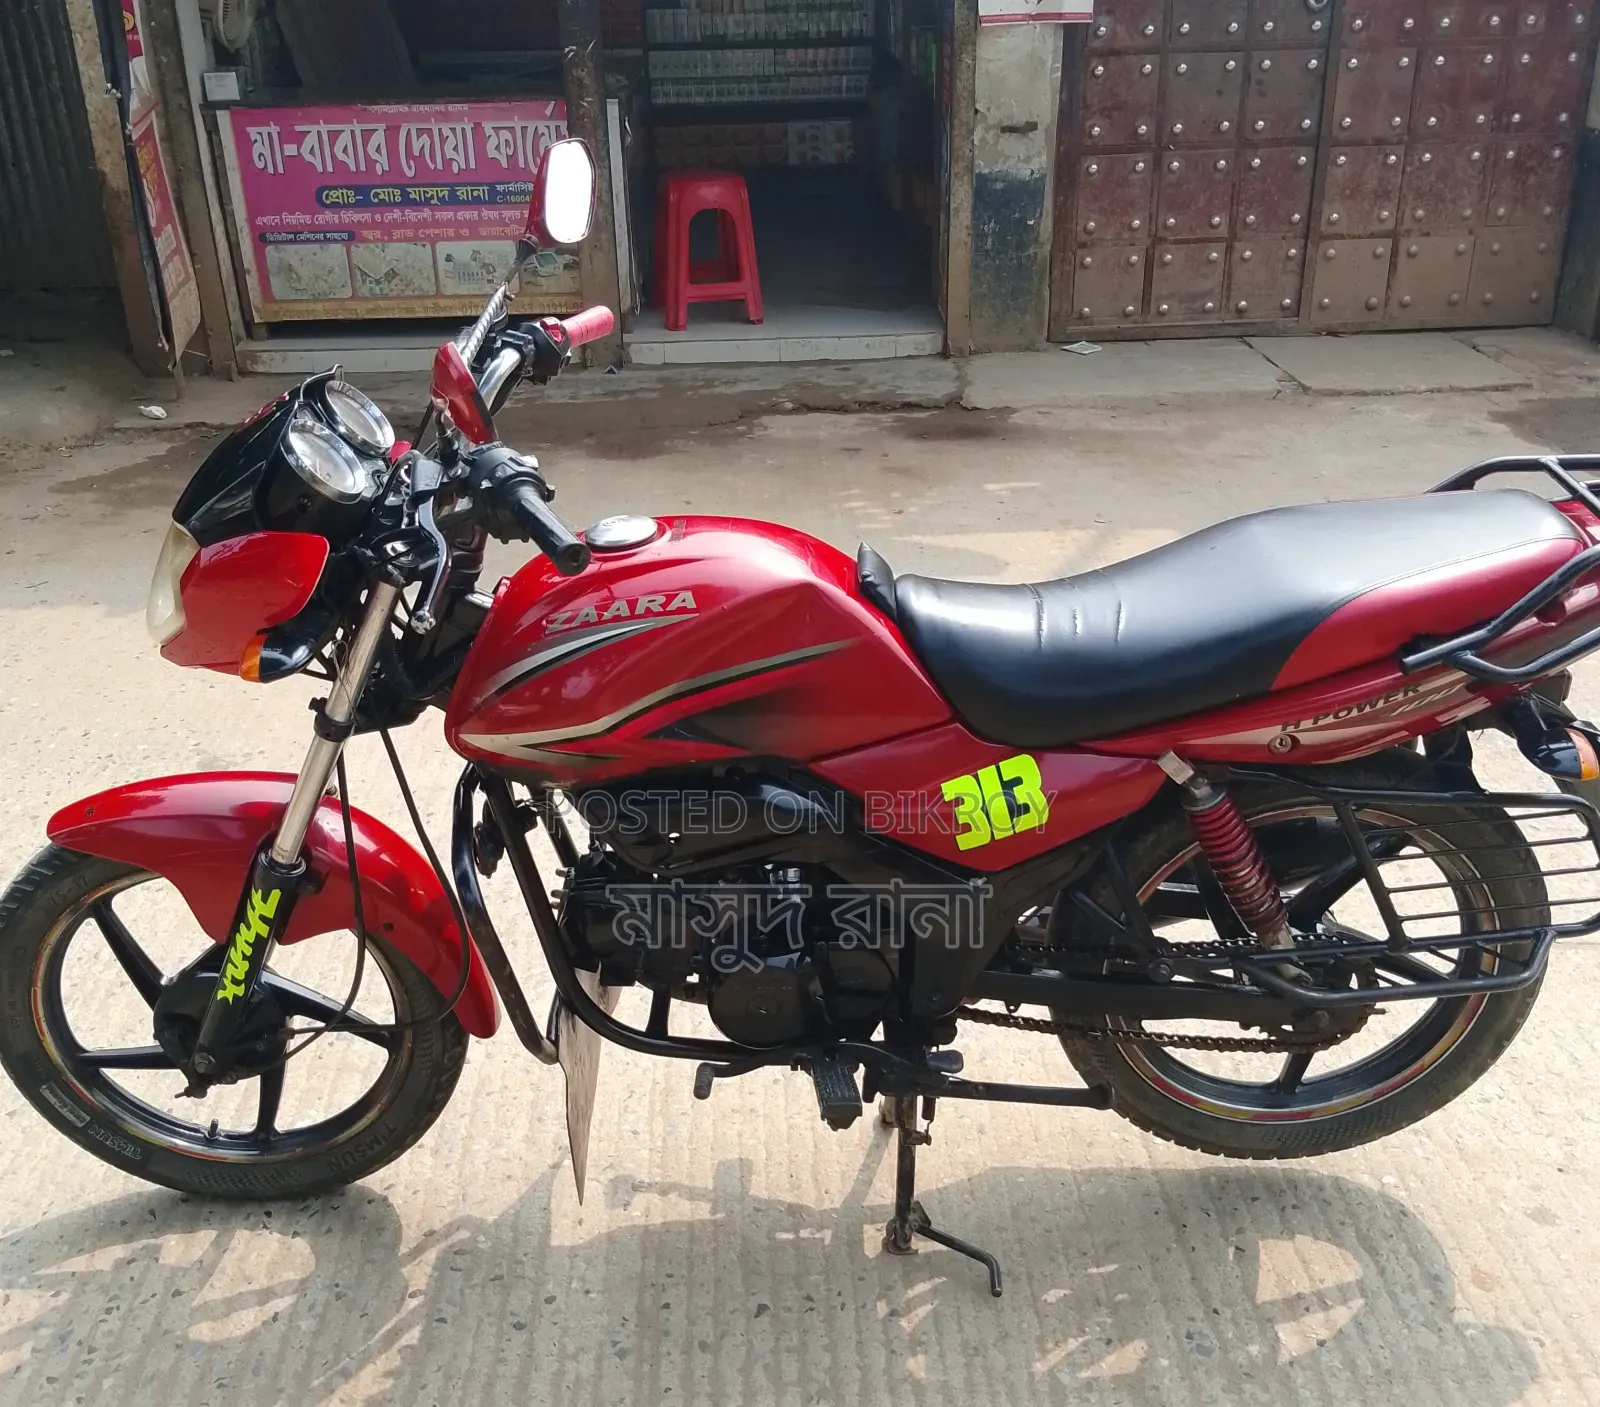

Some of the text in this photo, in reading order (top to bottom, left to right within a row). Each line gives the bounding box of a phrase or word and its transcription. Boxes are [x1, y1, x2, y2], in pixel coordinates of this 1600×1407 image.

[246, 118, 390, 177] মা-বাবার
[399, 116, 477, 178] দোয়া
[370, 186, 402, 203] মোঃ
[405, 185, 452, 206] মাসুদ
[454, 185, 490, 201] রানা
[496, 194, 533, 203] C-16004
[255, 215, 281, 226] এখানে
[282, 212, 313, 226] নিয়মিত
[314, 210, 340, 225] রোগীর
[373, 213, 382, 222] ও
[456, 210, 479, 221] প্রকার
[459, 228, 470, 237] ও
[545, 590, 698, 634] ZAARA
[1280, 684, 1421, 732] H POWER
